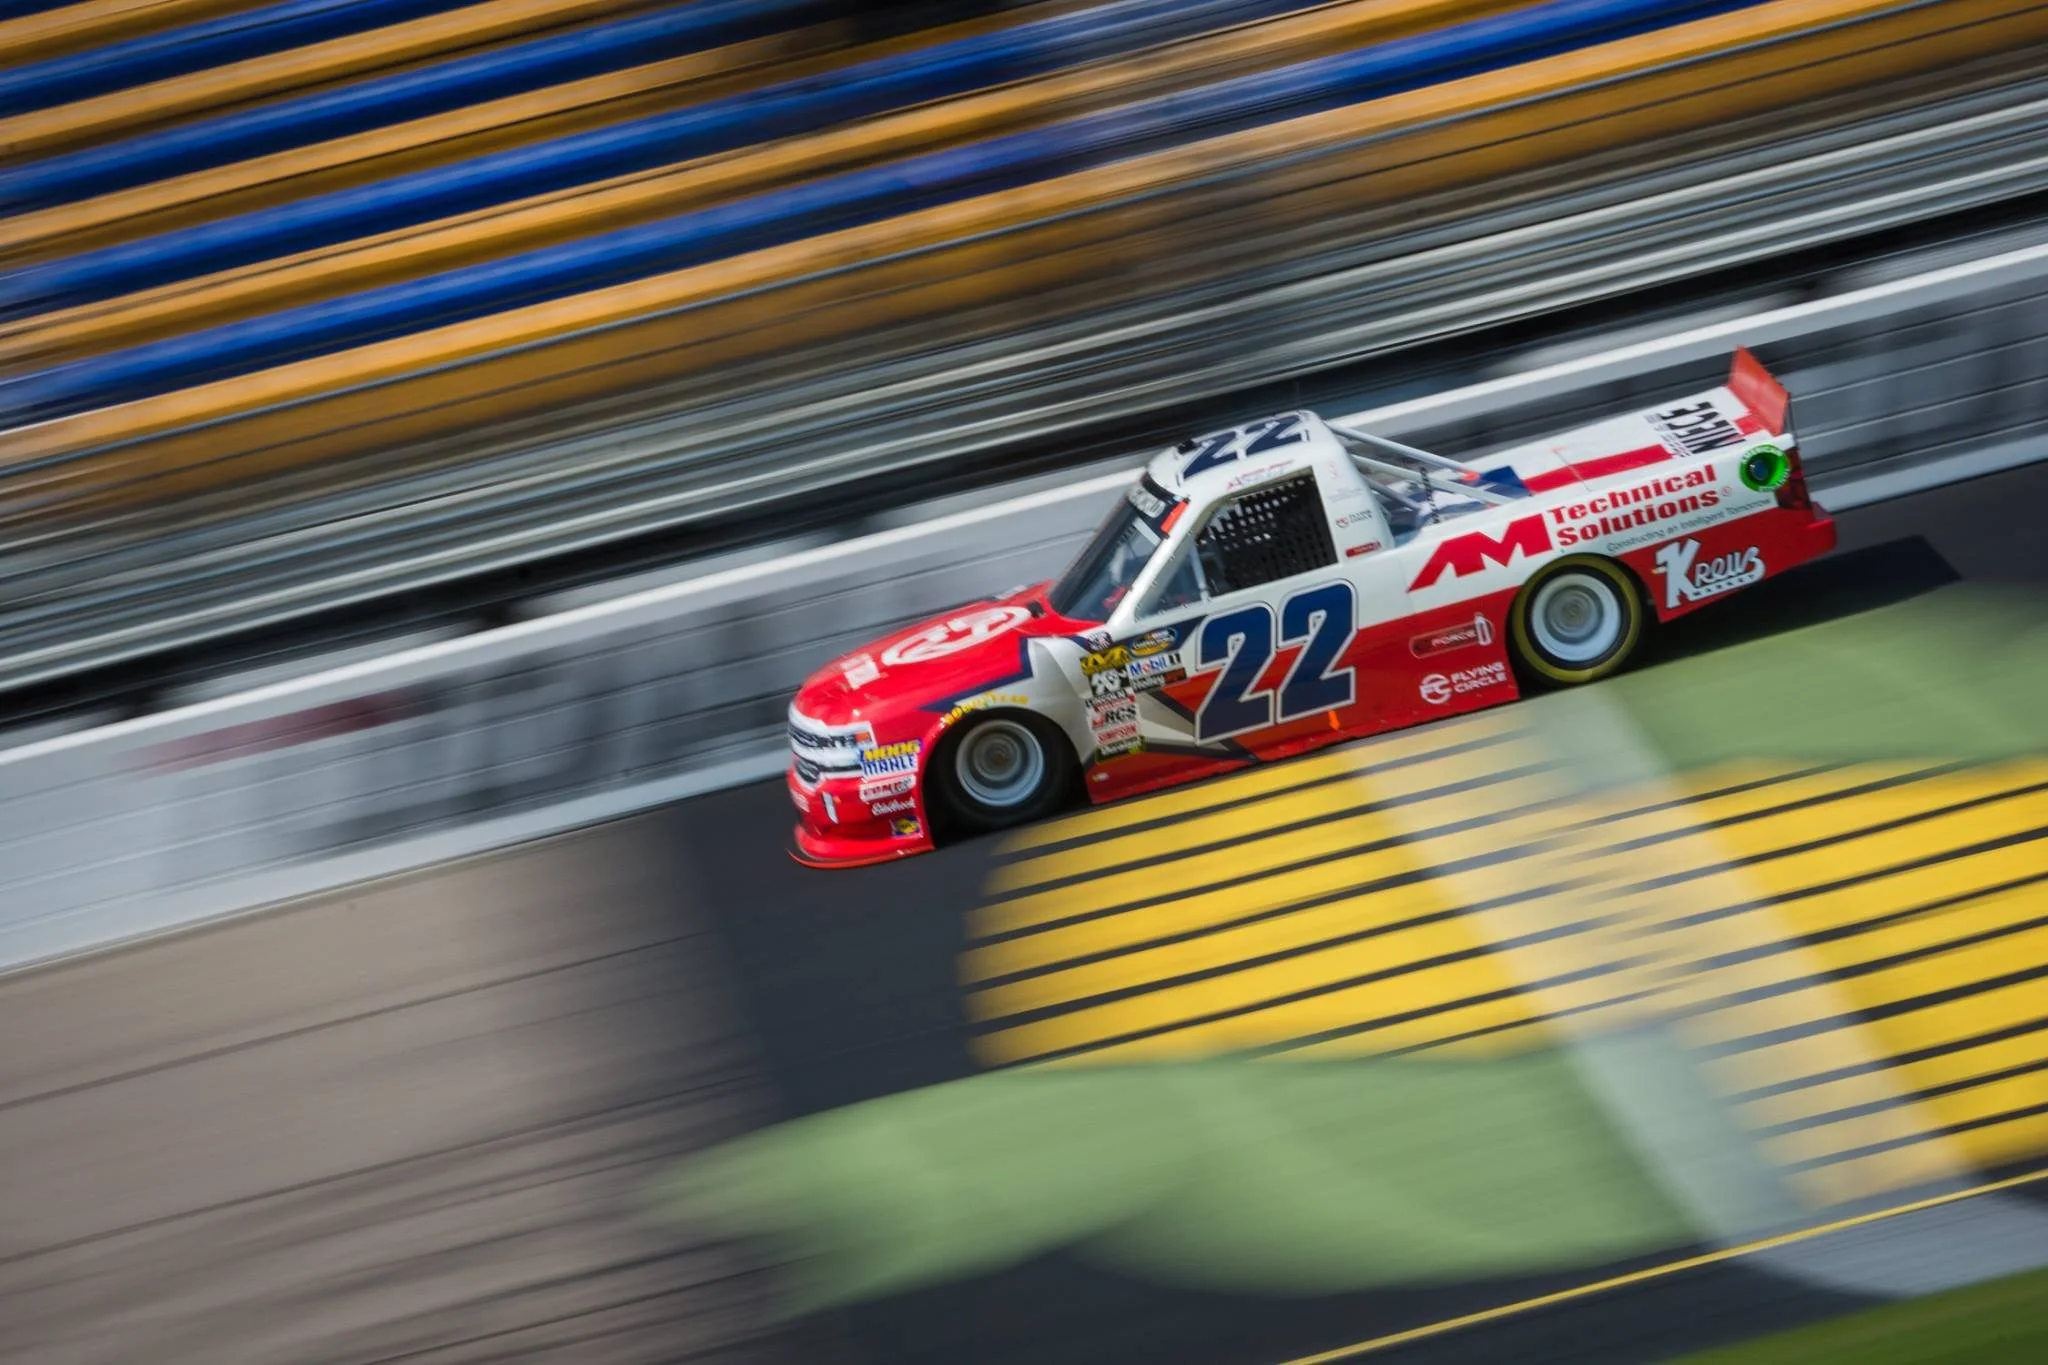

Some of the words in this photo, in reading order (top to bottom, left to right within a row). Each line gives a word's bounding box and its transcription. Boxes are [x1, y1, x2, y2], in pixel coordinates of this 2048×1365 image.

[1178, 411, 1308, 485] 22
[1547, 464, 1717, 524] Technical
[1556, 489, 1721, 547] Solutions
[1408, 513, 1552, 593] AM
[1129, 656, 1168, 677] Mobil
[1195, 578, 1358, 746] 22
[1451, 662, 1505, 684] FLYING
[1454, 672, 1507, 693] CIRCLE
